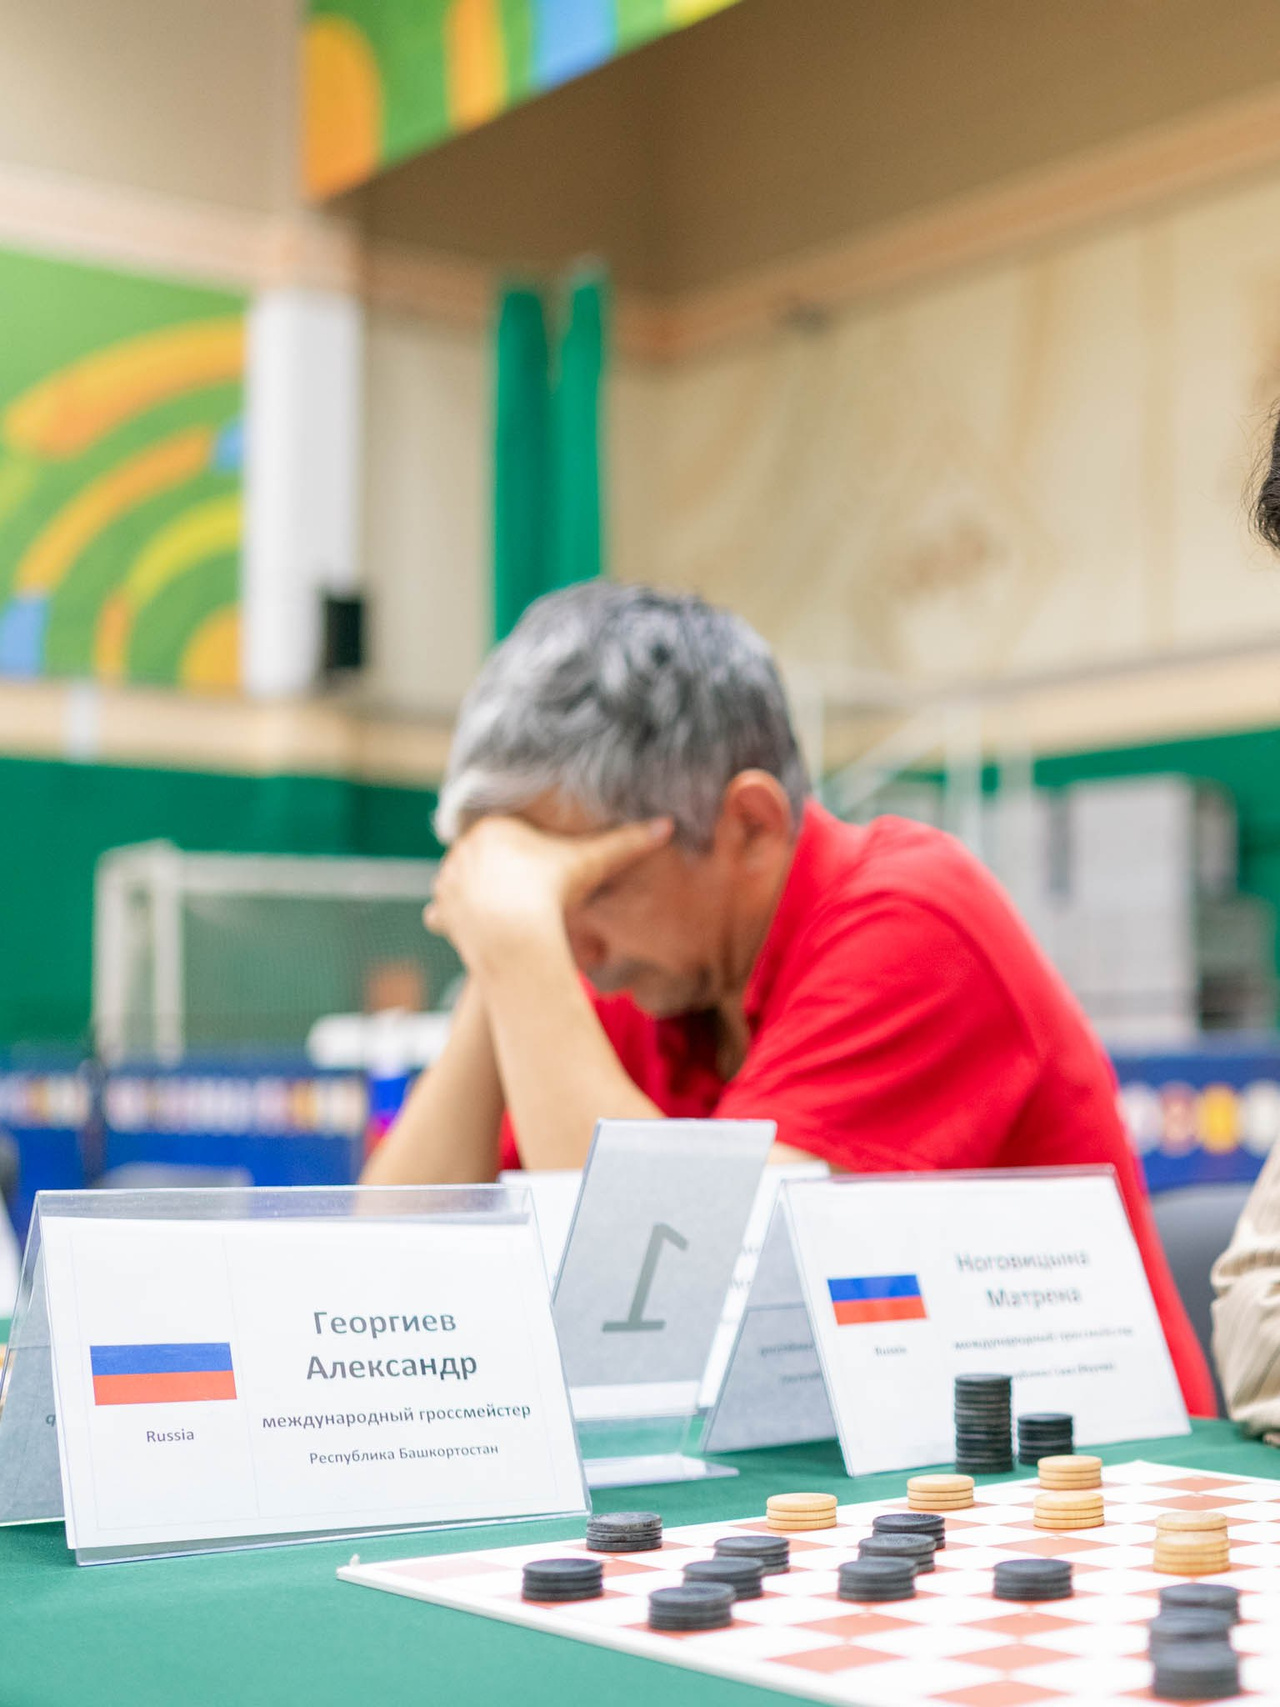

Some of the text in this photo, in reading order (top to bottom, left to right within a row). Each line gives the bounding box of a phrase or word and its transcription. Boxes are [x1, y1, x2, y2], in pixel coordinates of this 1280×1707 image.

[313, 1310, 457, 1339] Георгиев
[306, 1354, 478, 1381] Александр
[261, 1402, 532, 1430] международный гроссмейстер
[145, 1427, 195, 1443] Russia
[309, 1443, 500, 1465] Республика Башкортостан
